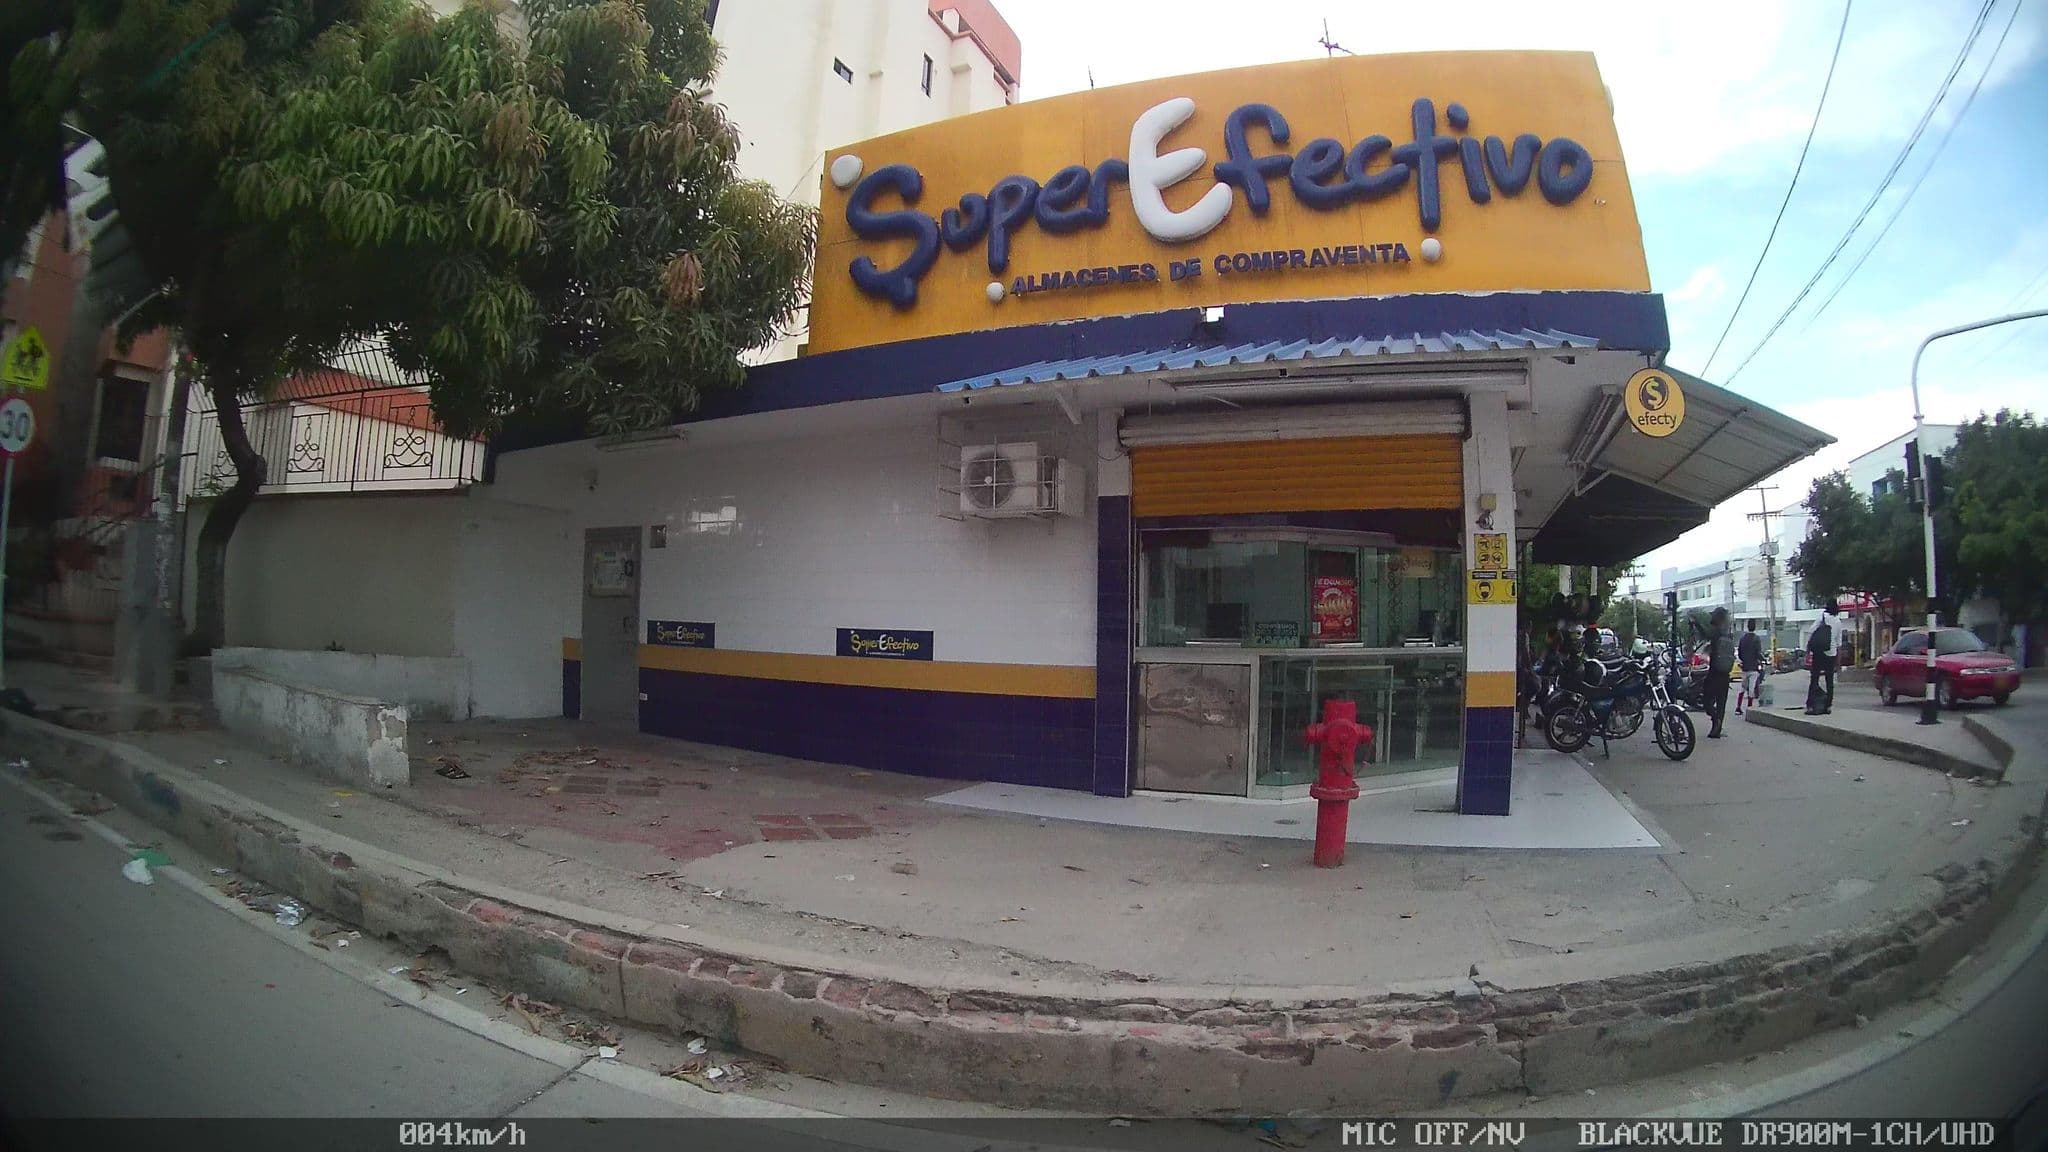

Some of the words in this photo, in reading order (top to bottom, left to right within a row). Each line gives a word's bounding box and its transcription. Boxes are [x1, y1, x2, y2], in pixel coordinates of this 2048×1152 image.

[1010, 262, 1157, 295] ALMACENES
[1169, 257, 1201, 281] DE
[1213, 242, 1412, 273] COMPRAVENTA
[2, 410, 31, 442] 30
[1637, 411, 1677, 428] efecty
